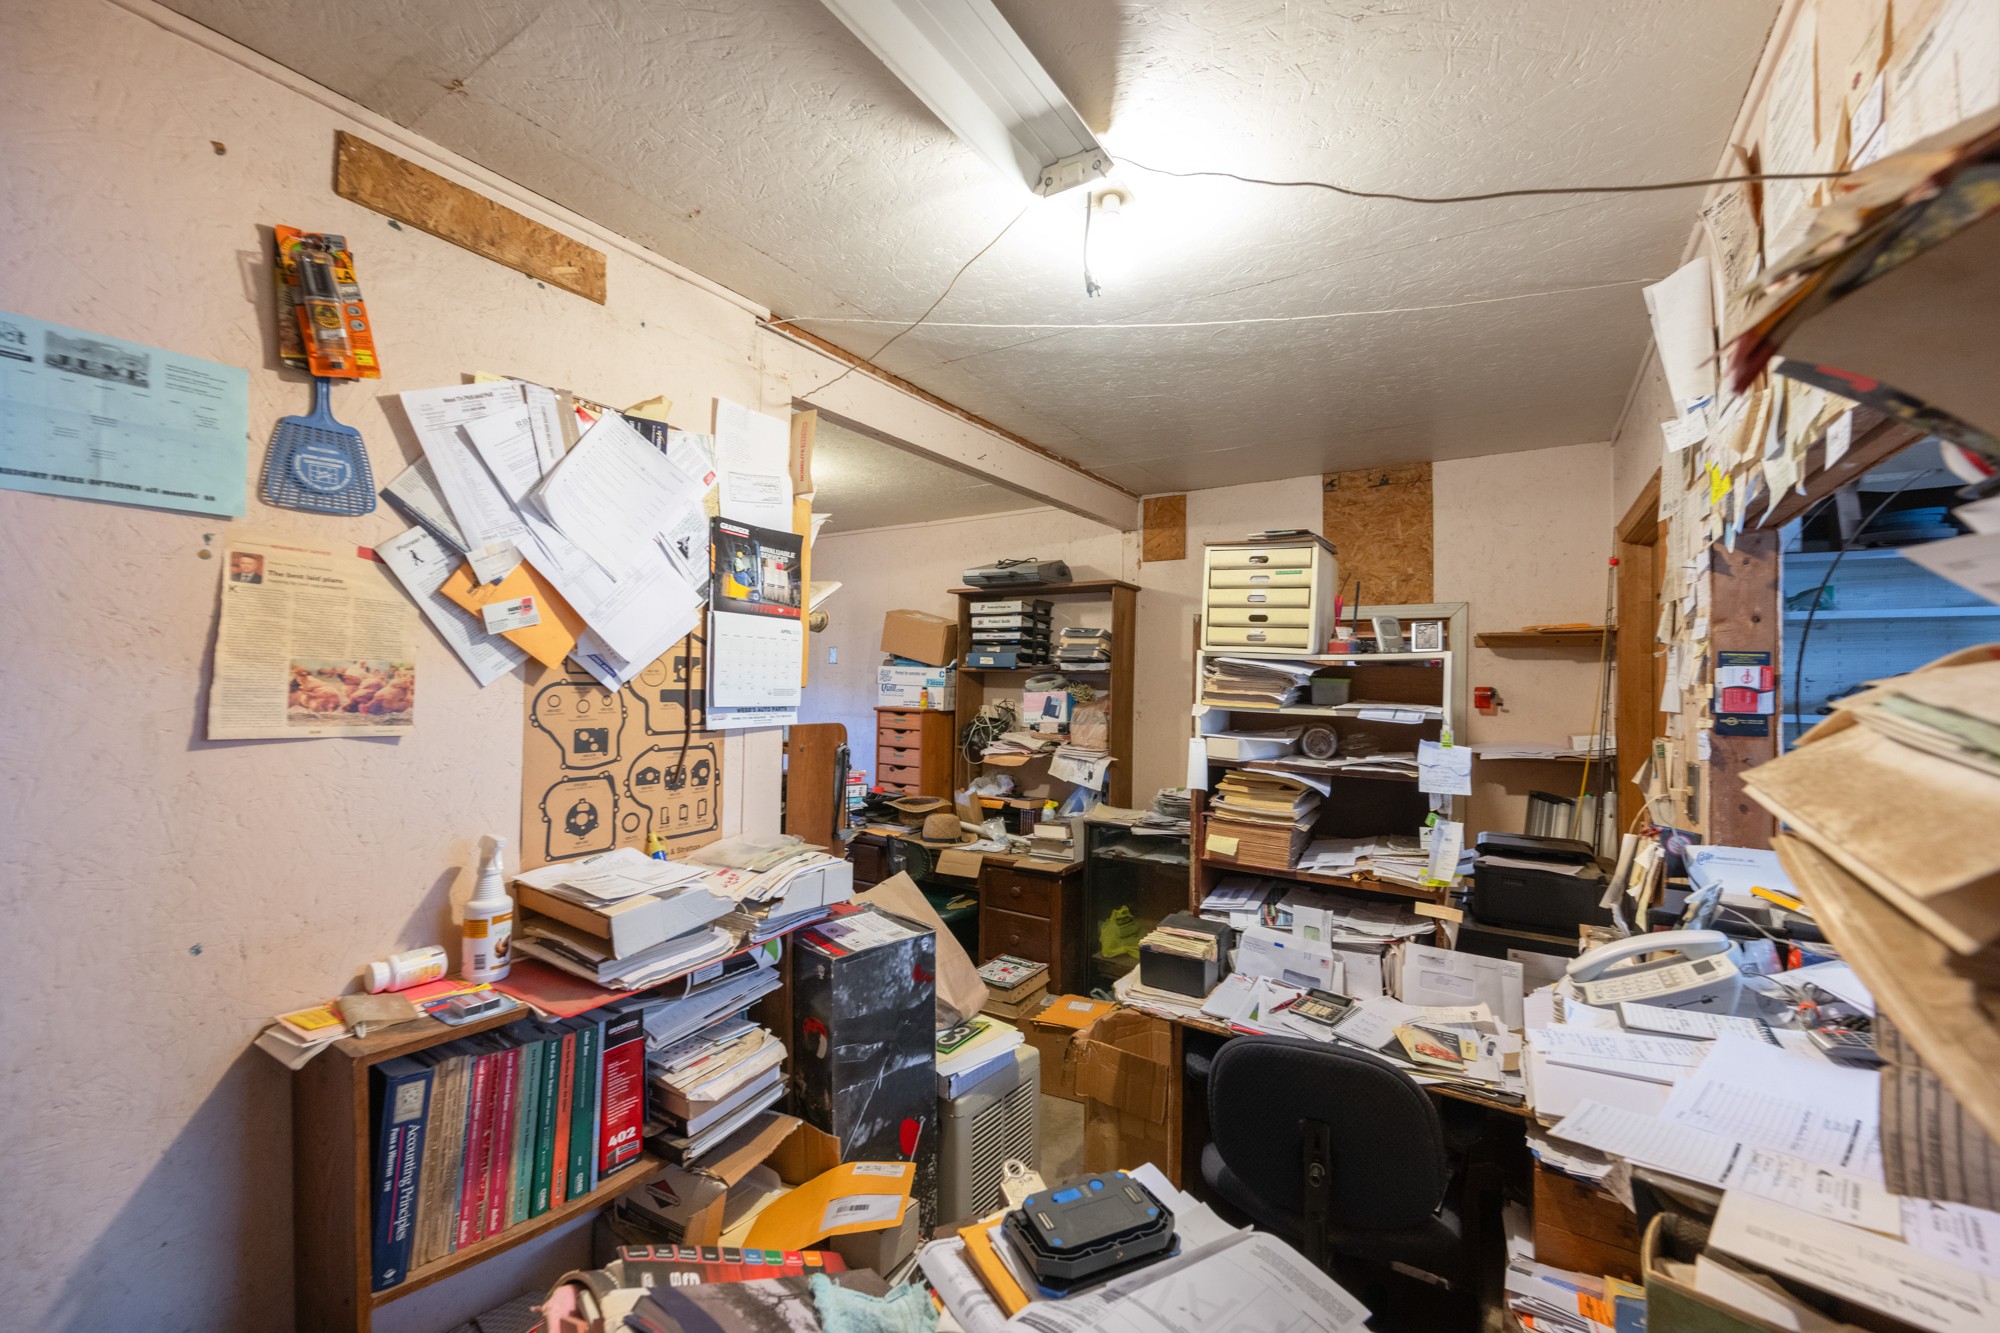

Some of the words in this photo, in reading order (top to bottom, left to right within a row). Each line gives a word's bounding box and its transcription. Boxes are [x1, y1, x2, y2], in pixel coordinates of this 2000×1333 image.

[54, 355, 148, 383] JUNE
[548, 1059, 556, 1078] Garden
[608, 1126, 637, 1147] 402
[398, 1123, 421, 1187] Accounting
[391, 1186, 415, 1241] Principles
